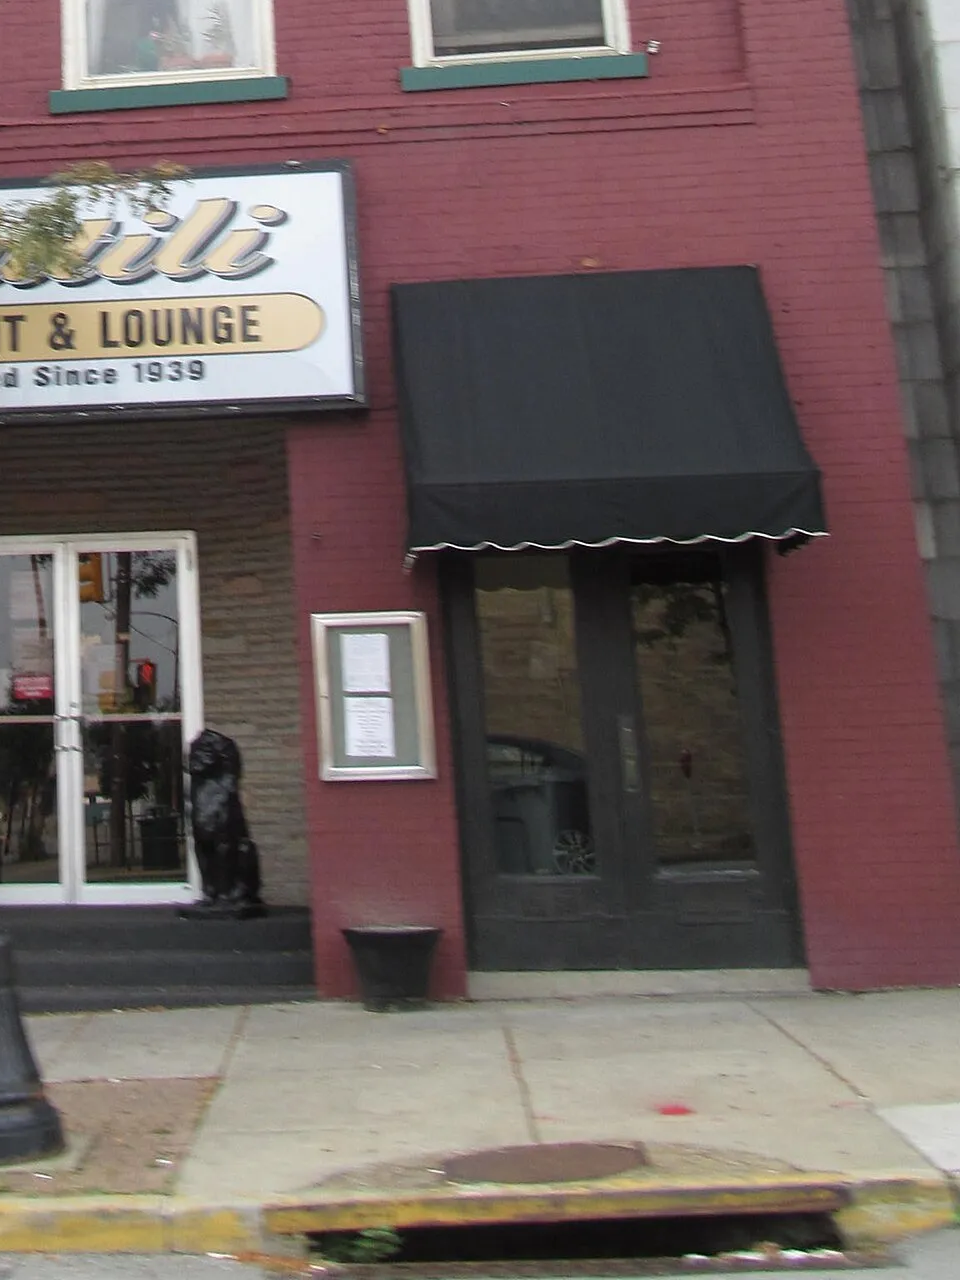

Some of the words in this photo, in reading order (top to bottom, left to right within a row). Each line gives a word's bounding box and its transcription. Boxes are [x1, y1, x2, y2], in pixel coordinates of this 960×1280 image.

[47, 312, 76, 350] &
[99, 304, 262, 348] LOUNGE
[34, 363, 120, 389] Since
[133, 359, 207, 386] 1939
